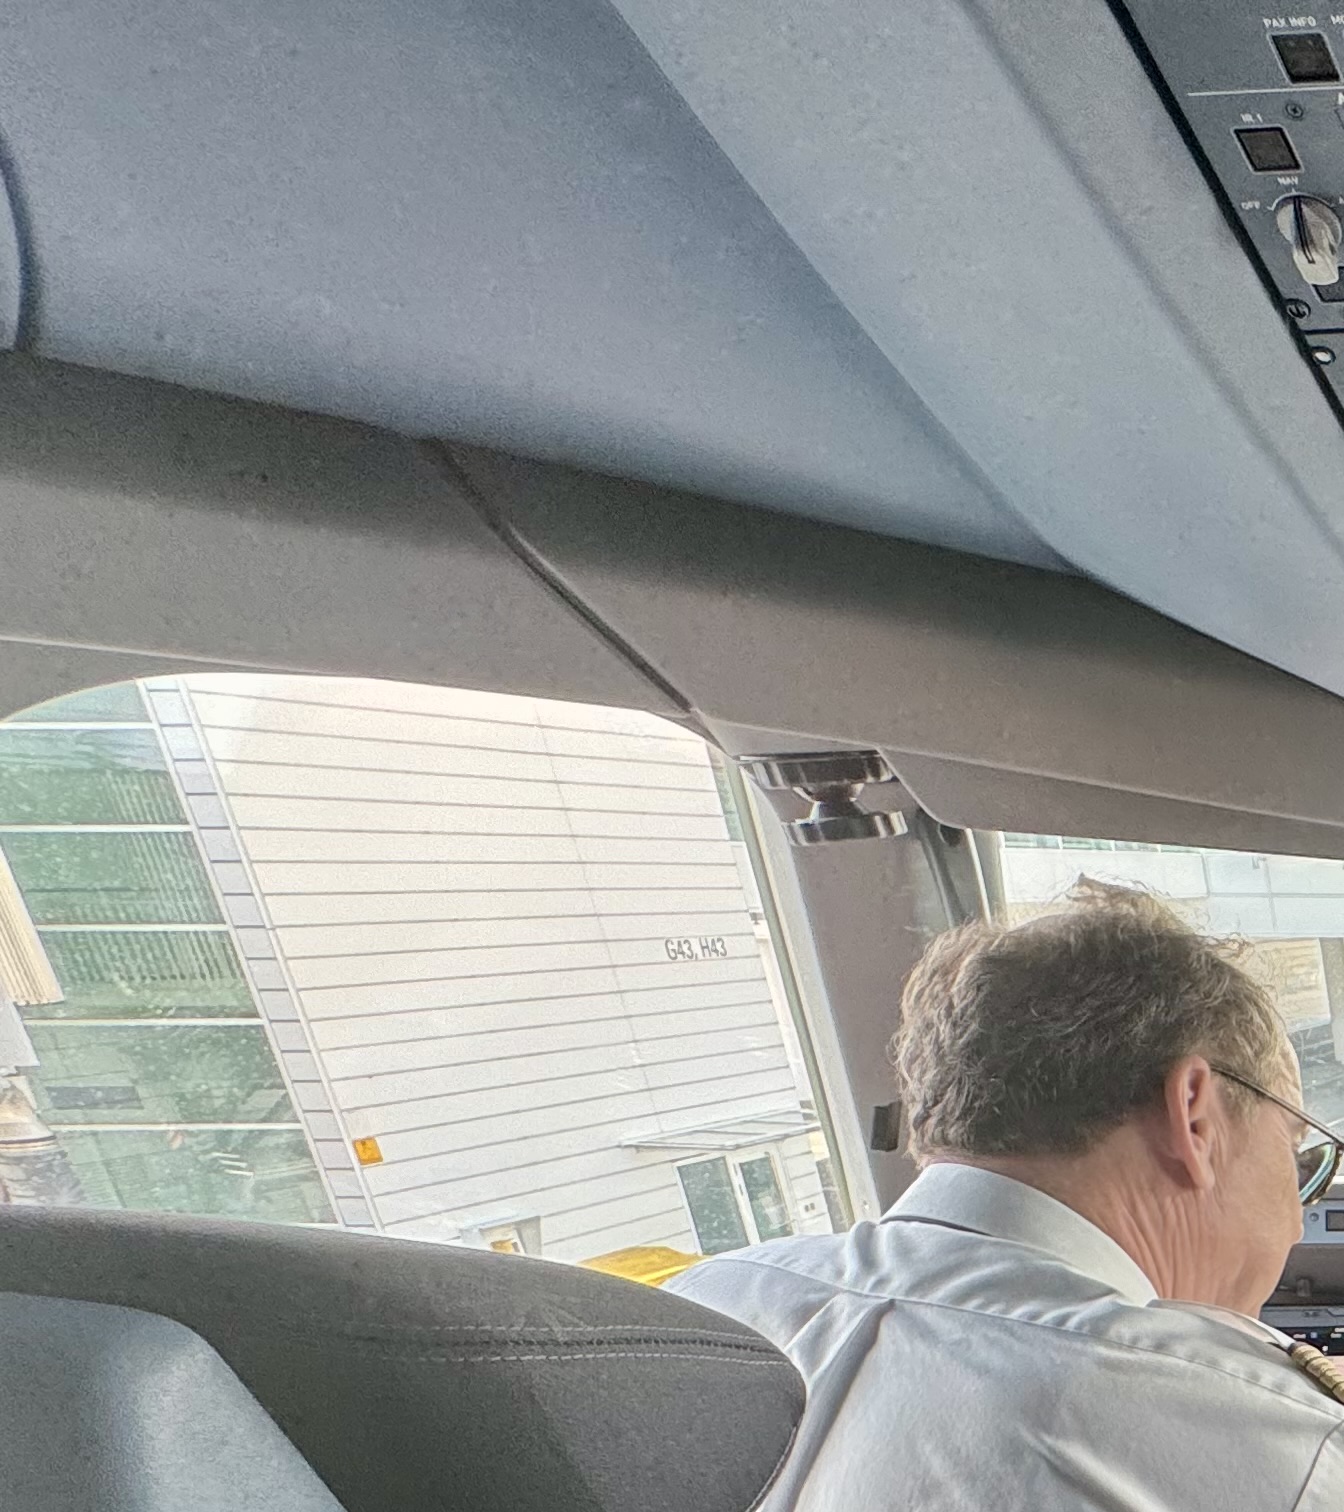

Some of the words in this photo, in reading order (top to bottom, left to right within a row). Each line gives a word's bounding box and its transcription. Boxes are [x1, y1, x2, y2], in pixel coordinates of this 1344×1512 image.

[1290, 15, 1317, 27] INFO
[665, 938, 699, 961] G43,
[699, 936, 728, 958] H43
